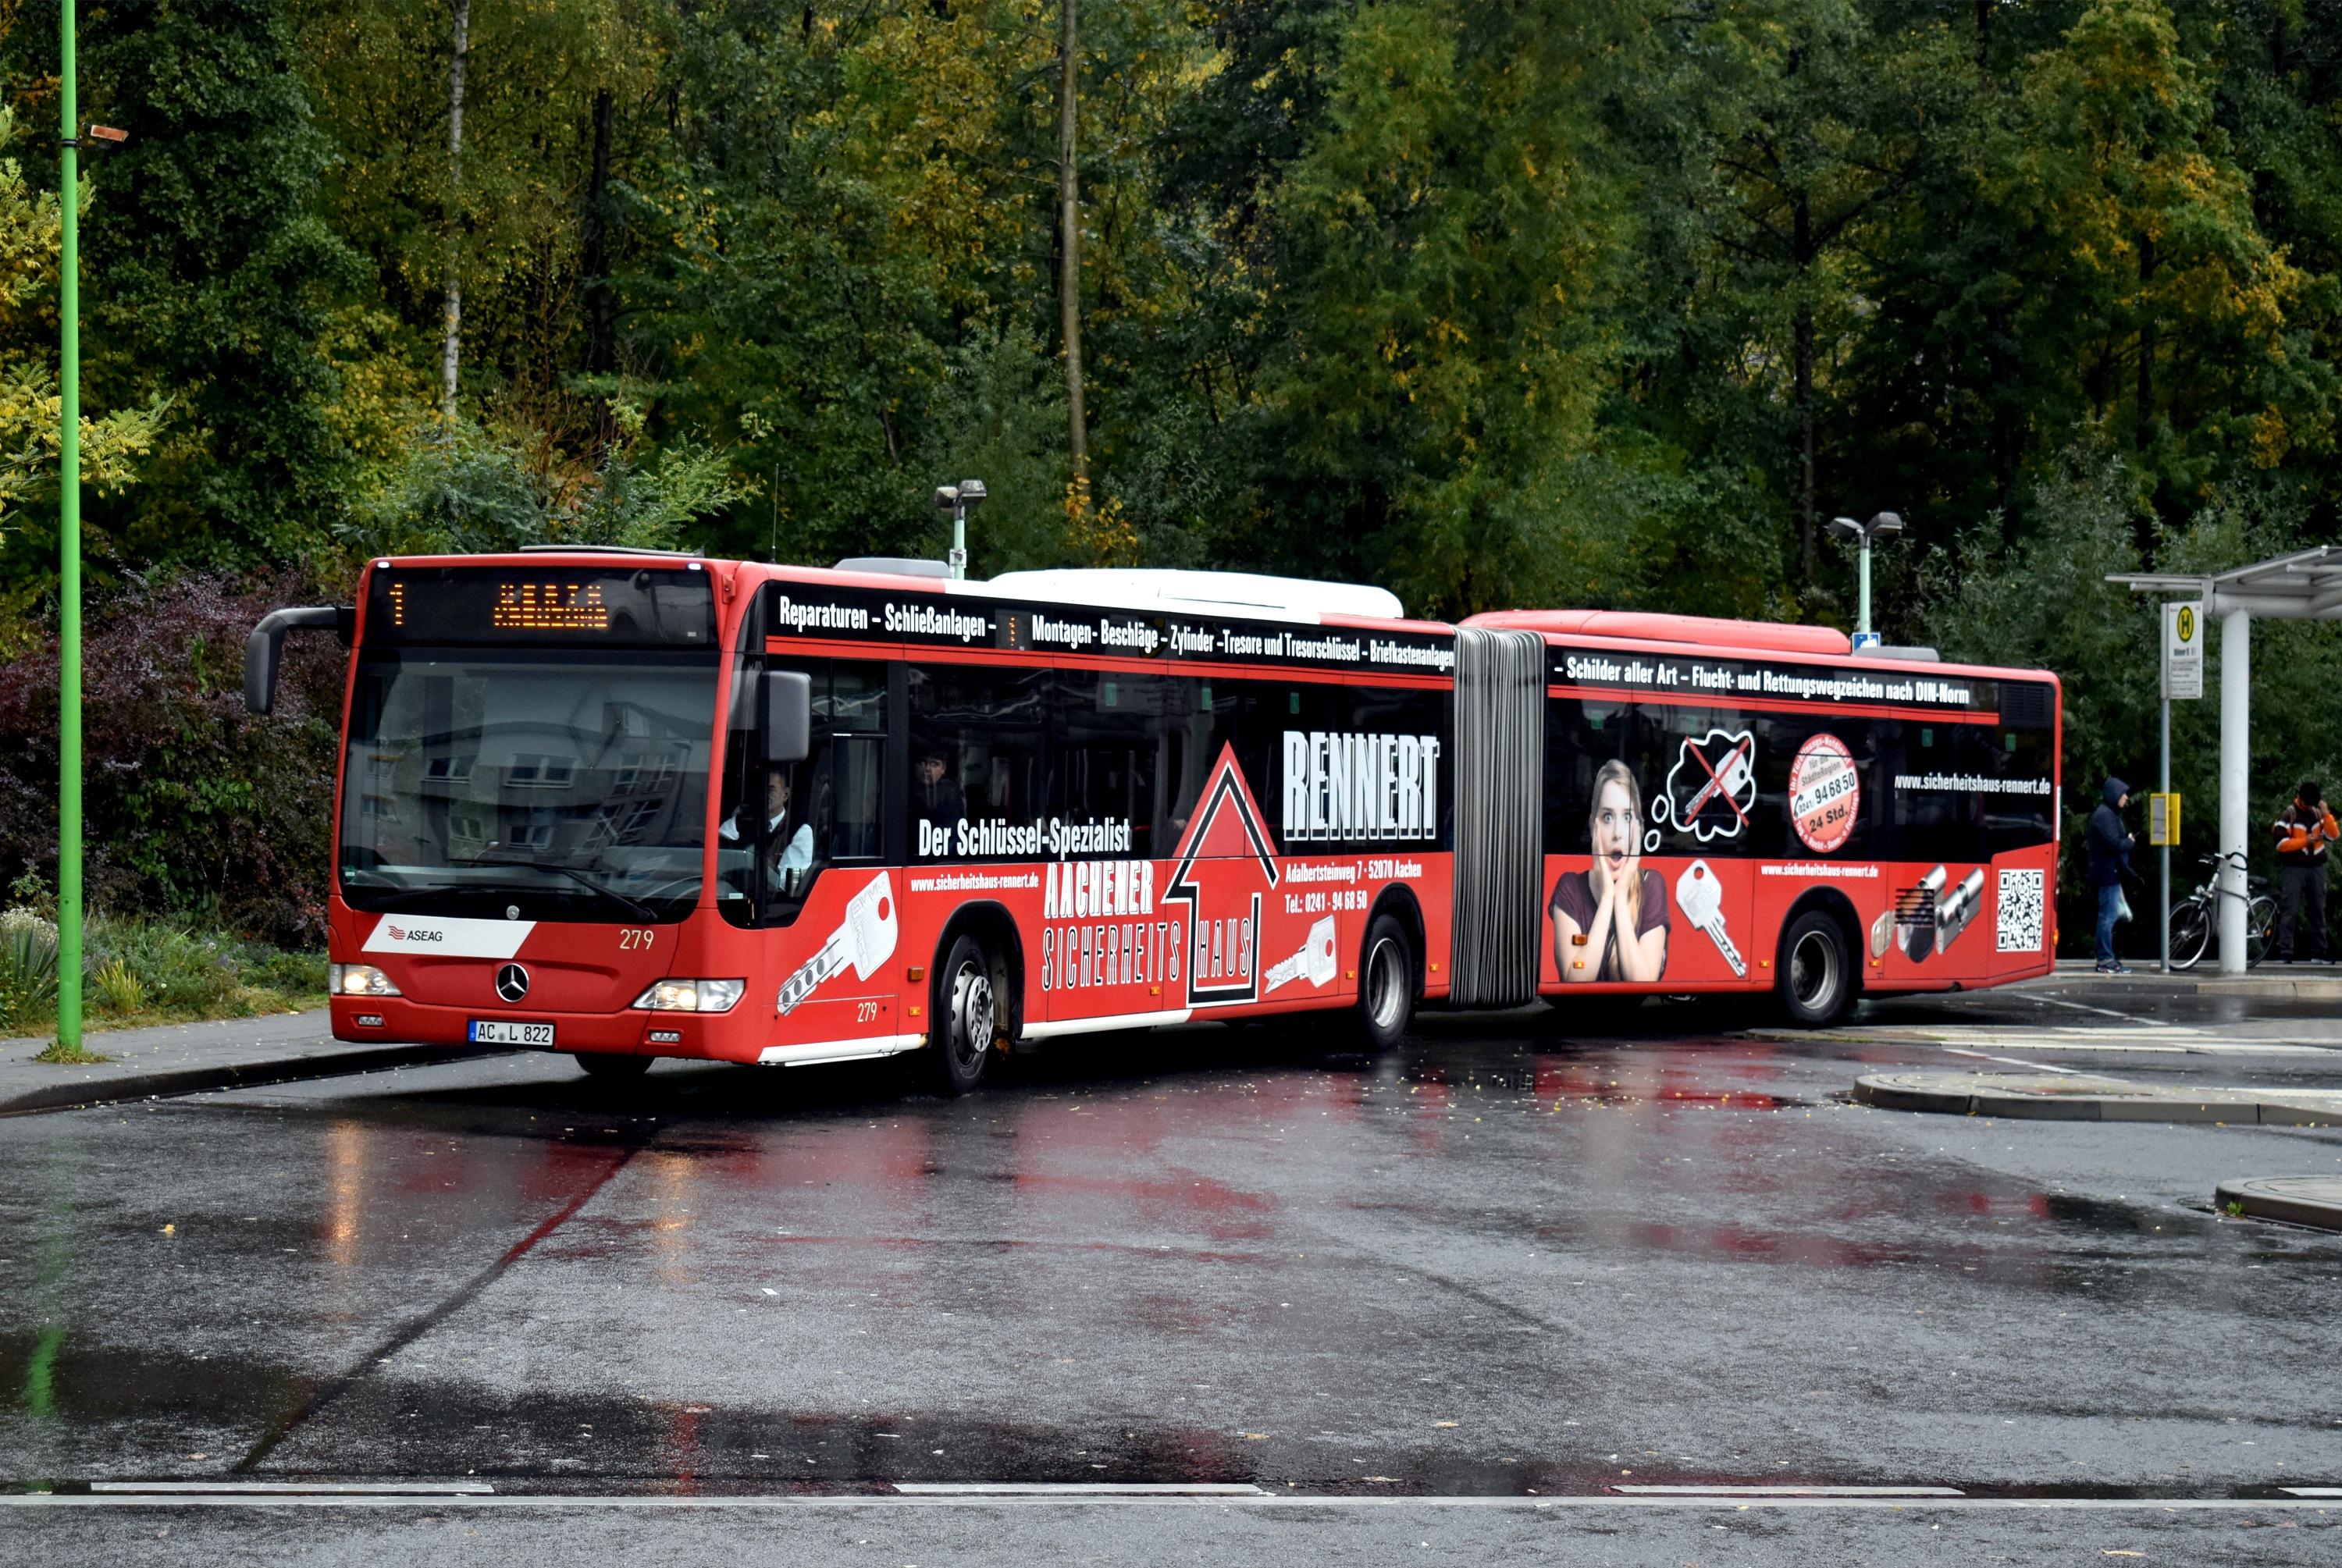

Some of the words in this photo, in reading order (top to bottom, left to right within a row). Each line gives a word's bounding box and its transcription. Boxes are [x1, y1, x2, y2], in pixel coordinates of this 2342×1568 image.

[390, 584, 402, 625] 1
[780, 596, 868, 632] Reparaturen
[884, 603, 985, 642] Schließanlagen
[1101, 619, 1158, 653] Beschläge
[1170, 624, 1214, 655] Zylinder
[1264, 633, 1283, 656] und
[1284, 633, 1360, 661] Tresorschlüssel
[1370, 639, 1454, 671] Briefkastenanlagen
[1567, 656, 1621, 681] Schilder
[1624, 661, 1653, 684] aller
[1657, 663, 1678, 685] Art
[1692, 666, 1735, 689] Flucht-
[1738, 670, 1760, 691] und
[1764, 670, 1884, 701] Rettungswegzeichen
[1885, 681, 1913, 701] nach
[1916, 681, 1969, 704] DIN-Norm
[1283, 731, 1440, 841] RENNERT
[1809, 816, 1823, 833] 24
[1826, 804, 1848, 824] Std.
[919, 819, 952, 856] Der
[956, 817, 1130, 861] Schlüssel-Spezialist
[911, 872, 1039, 892] www.sicherheitshaus-rennert.de
[1285, 862, 1355, 884] Adalbertsteinweg
[1357, 861, 1362, 880] 7
[1368, 860, 1393, 880] 52070
[1394, 859, 1422, 878] Aachen
[1760, 863, 1878, 877] www.sicherheitshaus-rennert.de
[1044, 860, 1153, 919] AACHENER
[1285, 894, 1303, 913] Tel.:
[1305, 893, 1326, 912] 0241
[1332, 892, 1343, 911] 94
[1344, 891, 1355, 910] 68
[1356, 891, 1368, 909] 50
[407, 930, 443, 942] ASEAG
[619, 929, 654, 950] 279
[1041, 919, 1180, 991] SICHERHEITS
[1198, 917, 1251, 980] HAUS
[857, 1002, 877, 1022] 279
[478, 1024, 495, 1040] AC
[509, 1026, 518, 1040] L
[524, 1026, 550, 1043] 822
